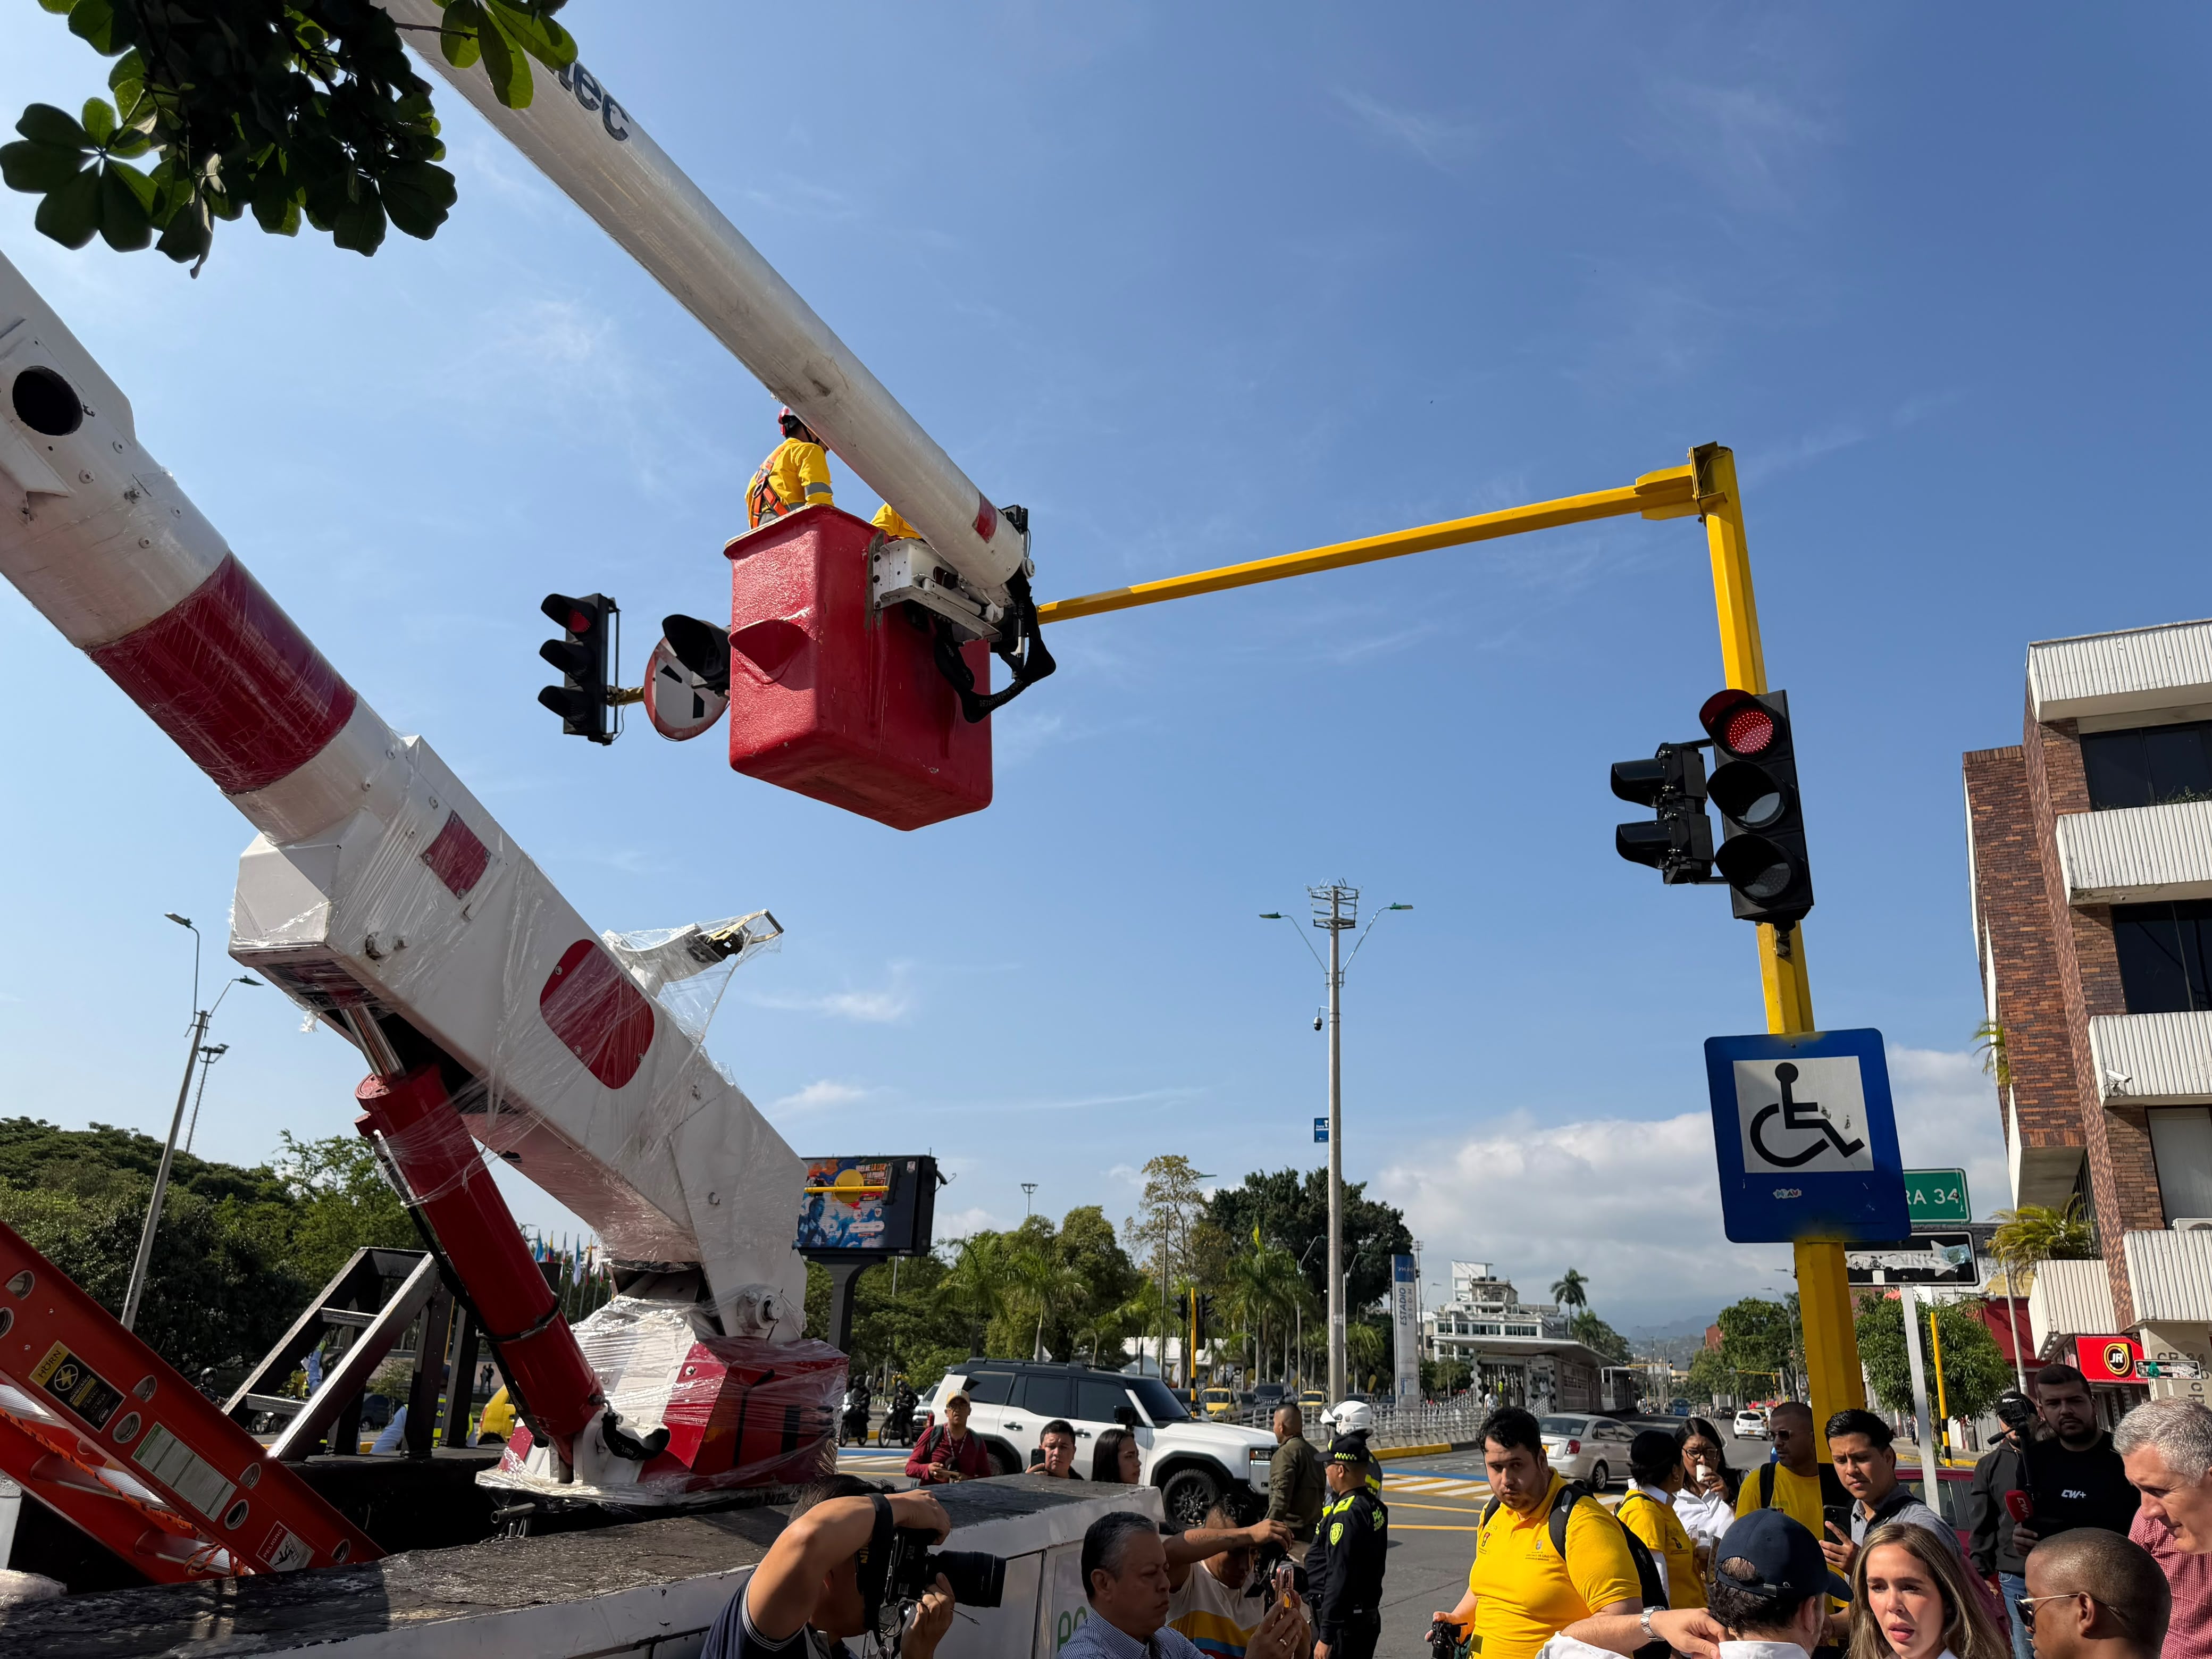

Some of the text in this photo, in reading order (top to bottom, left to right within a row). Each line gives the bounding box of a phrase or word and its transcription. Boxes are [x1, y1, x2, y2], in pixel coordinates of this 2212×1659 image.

[1933, 1188, 1959, 1204] 34
[2109, 1352, 2124, 1363] JR
[263, 1528, 283, 1558] PELIGRO
